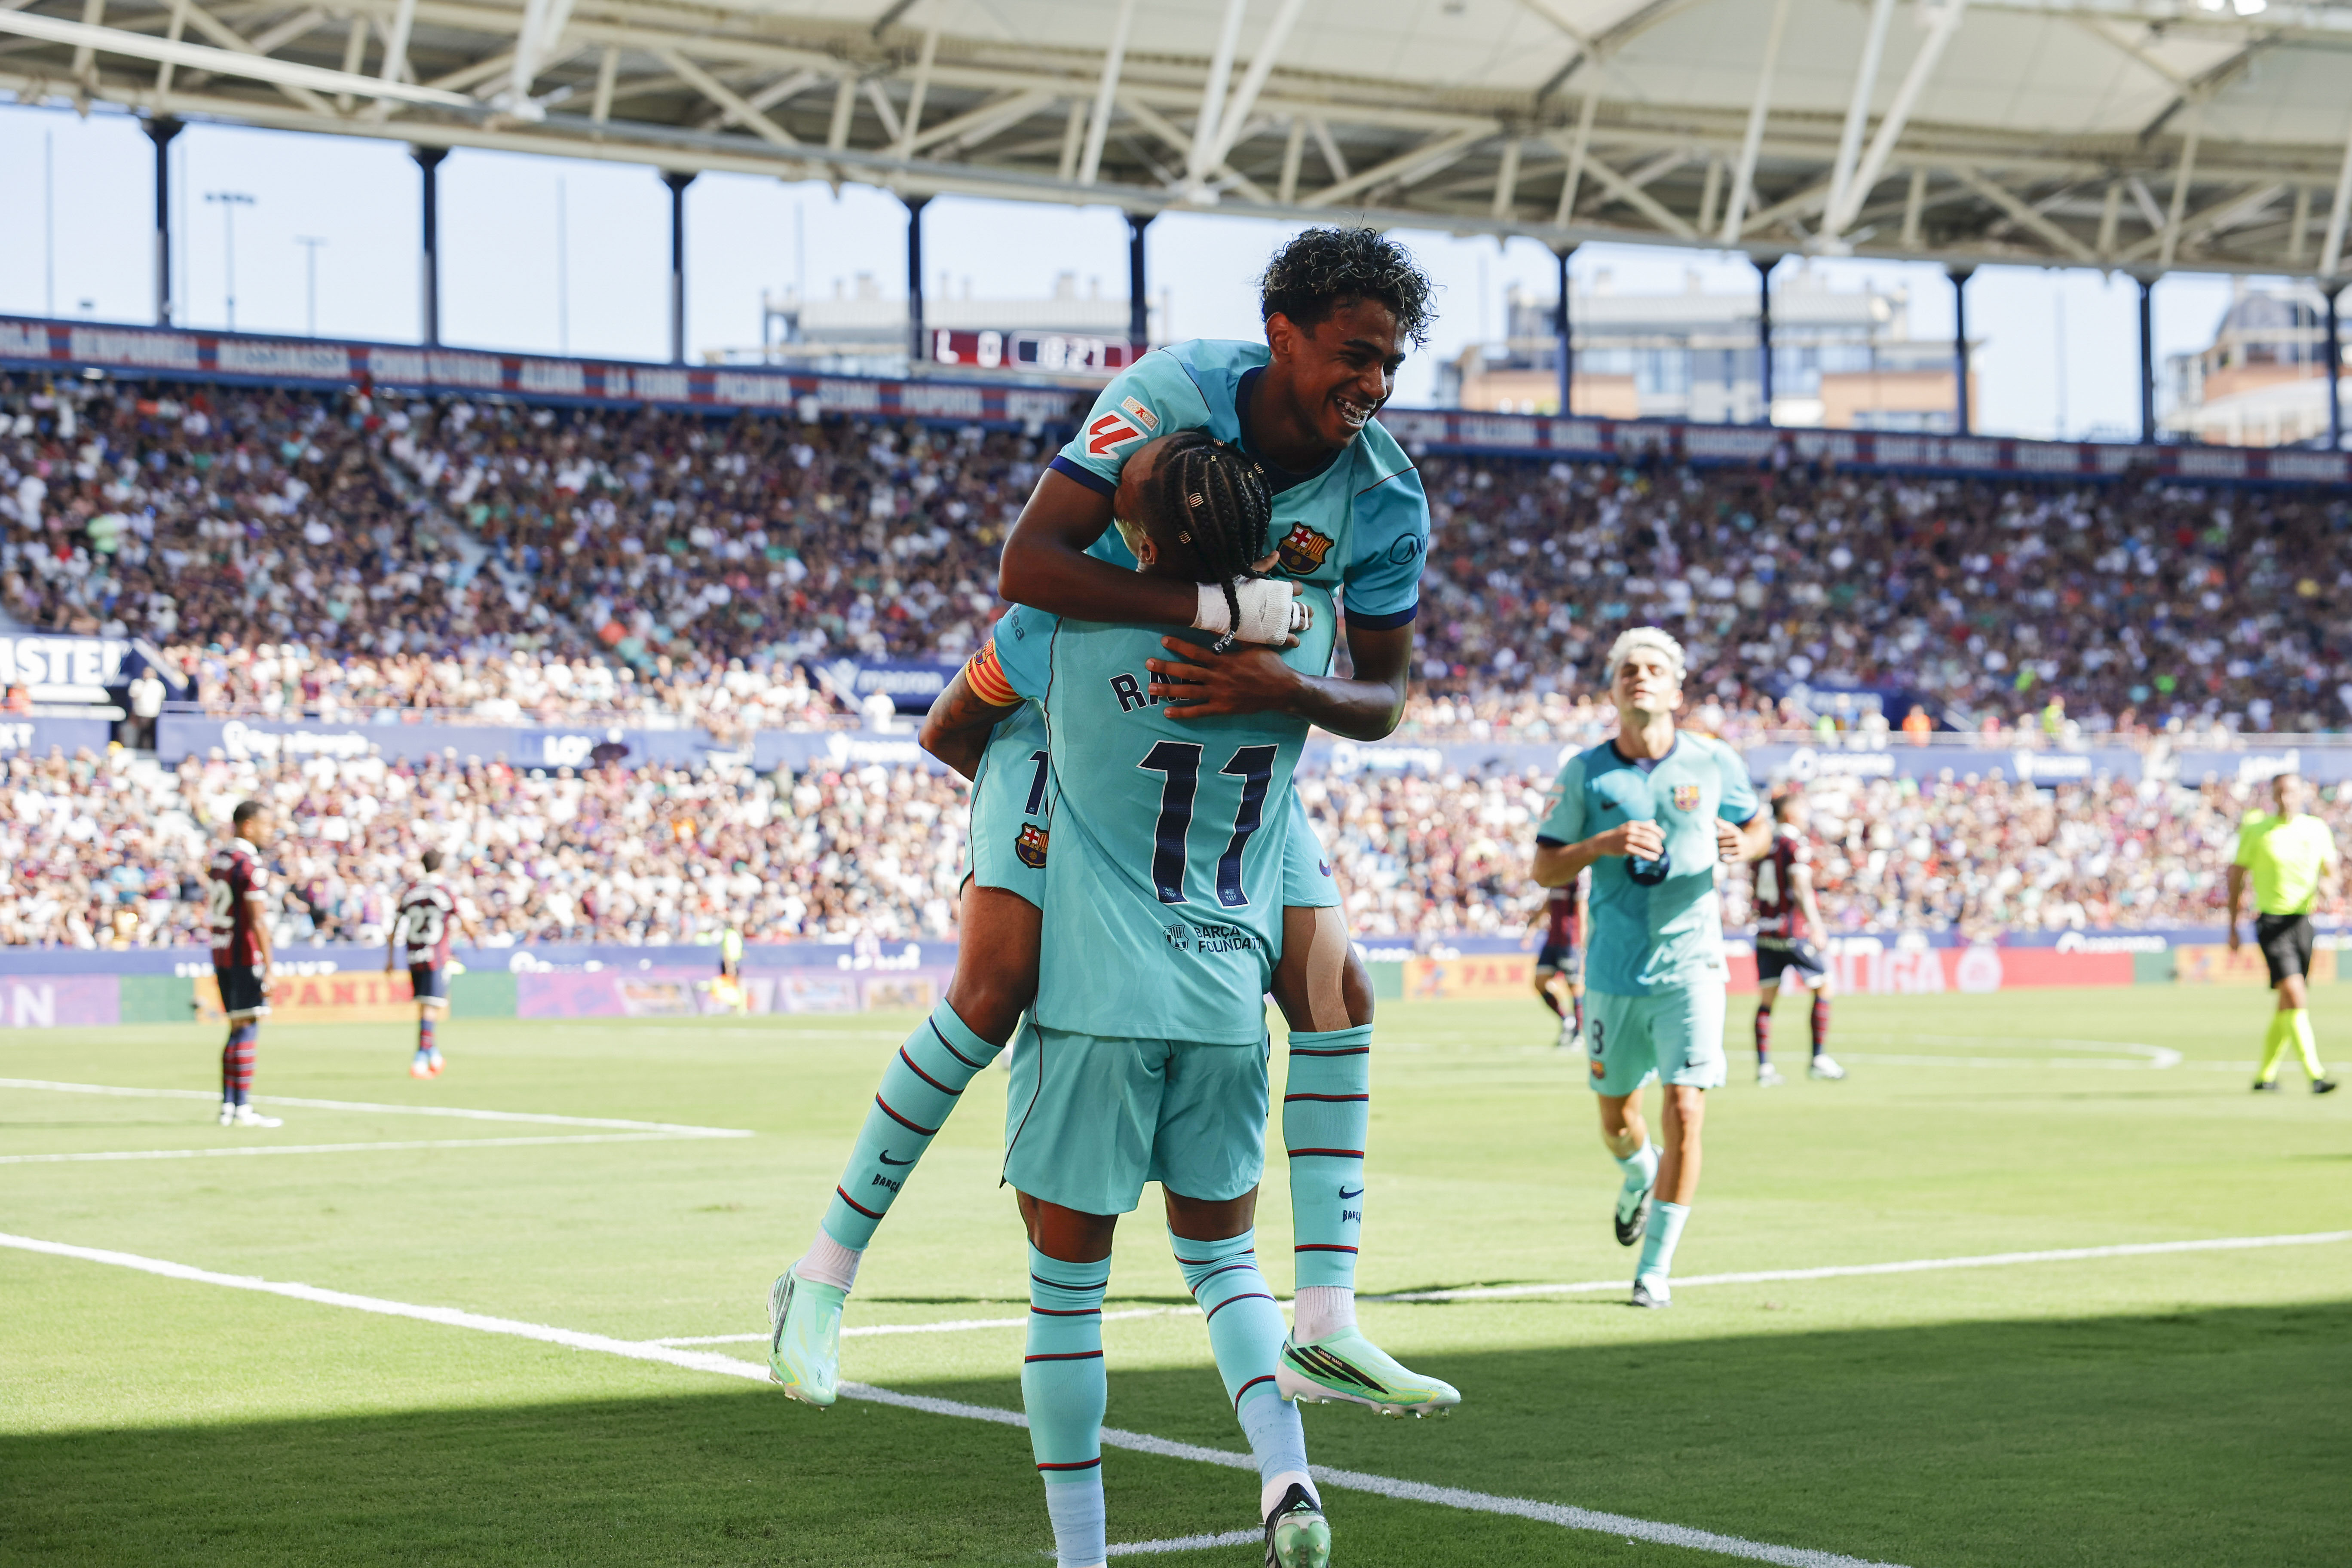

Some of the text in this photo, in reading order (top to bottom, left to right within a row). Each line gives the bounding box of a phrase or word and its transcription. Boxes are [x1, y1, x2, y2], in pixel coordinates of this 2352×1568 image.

[1293, 545, 1311, 557] FCB
[1010, 603, 1025, 641] dea
[1023, 750, 1048, 818] 1
[1135, 739, 1280, 909] 11
[1029, 841, 1043, 852] FCB
[209, 878, 236, 929] 2
[406, 905, 444, 945] 23
[1193, 925, 1240, 939] BARÇA
[1462, 964, 1525, 986] PAN
[0, 984, 56, 1028] N
[271, 980, 414, 1007] PANIN
[1342, 1210, 1361, 1224] BARÇA
[1318, 1348, 1343, 1367] LAMINE YAMAL
